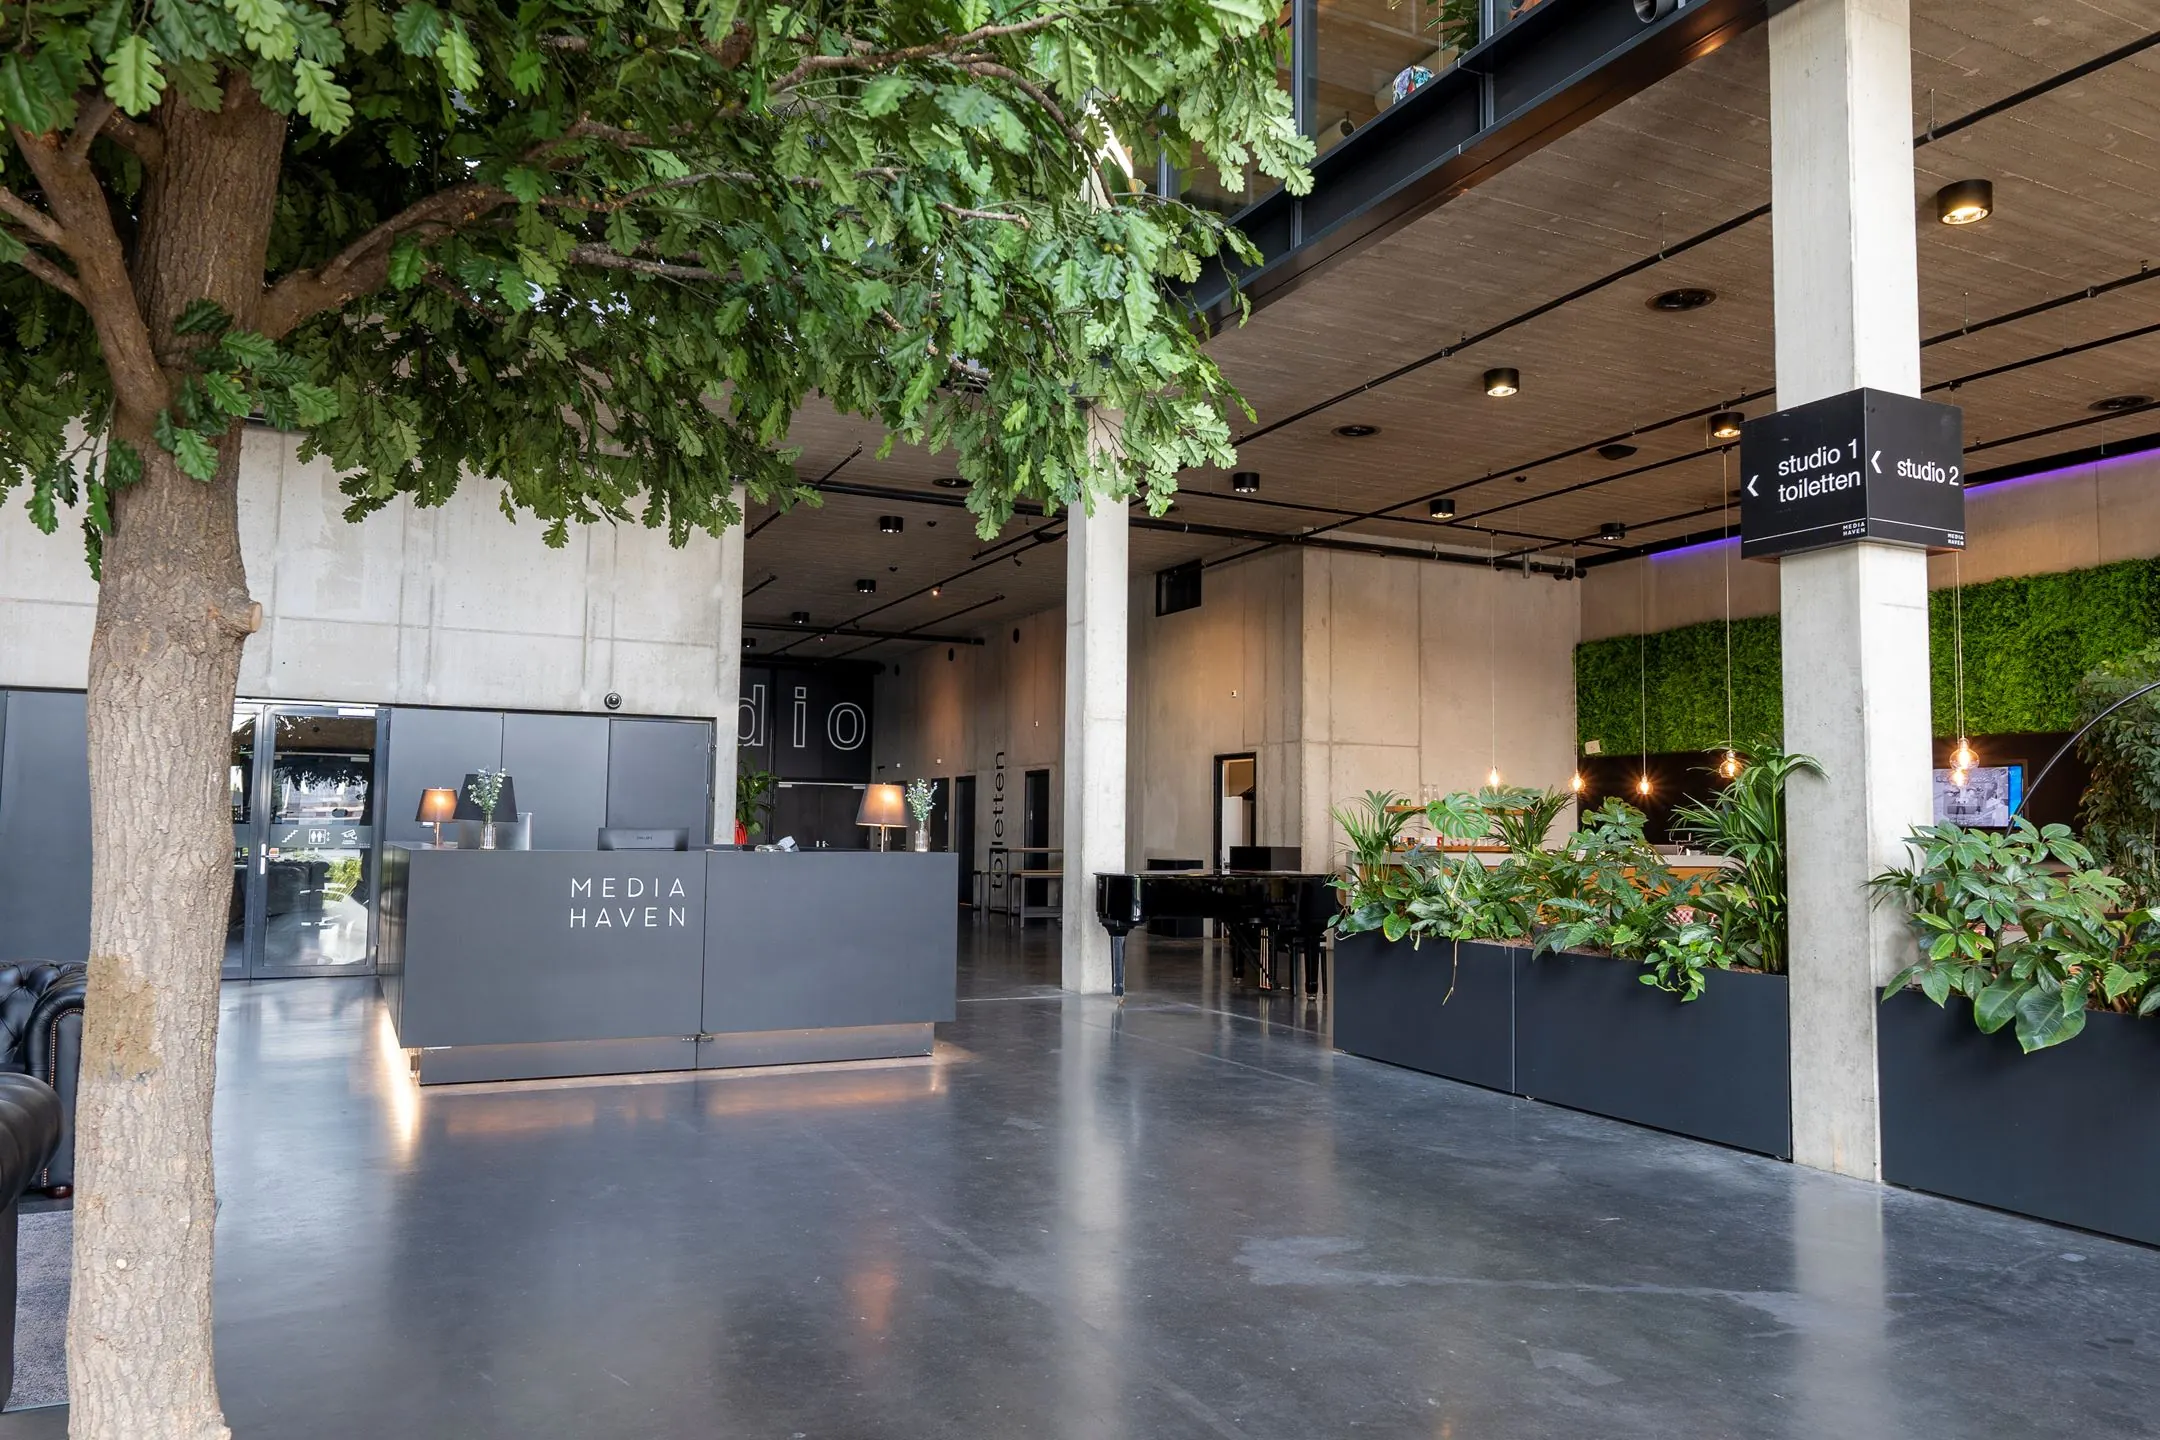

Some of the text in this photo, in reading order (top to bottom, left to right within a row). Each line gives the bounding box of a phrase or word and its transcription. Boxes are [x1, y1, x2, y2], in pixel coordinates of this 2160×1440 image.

[1777, 438, 1858, 477] studio 1
[1897, 458, 1960, 487] studio 2
[1777, 470, 1861, 503] toiletten
[1842, 521, 1865, 530] MEDIA
[1842, 527, 1866, 536] HAVEN
[570, 877, 686, 898] MEDIA
[569, 907, 686, 928] HAVEN
